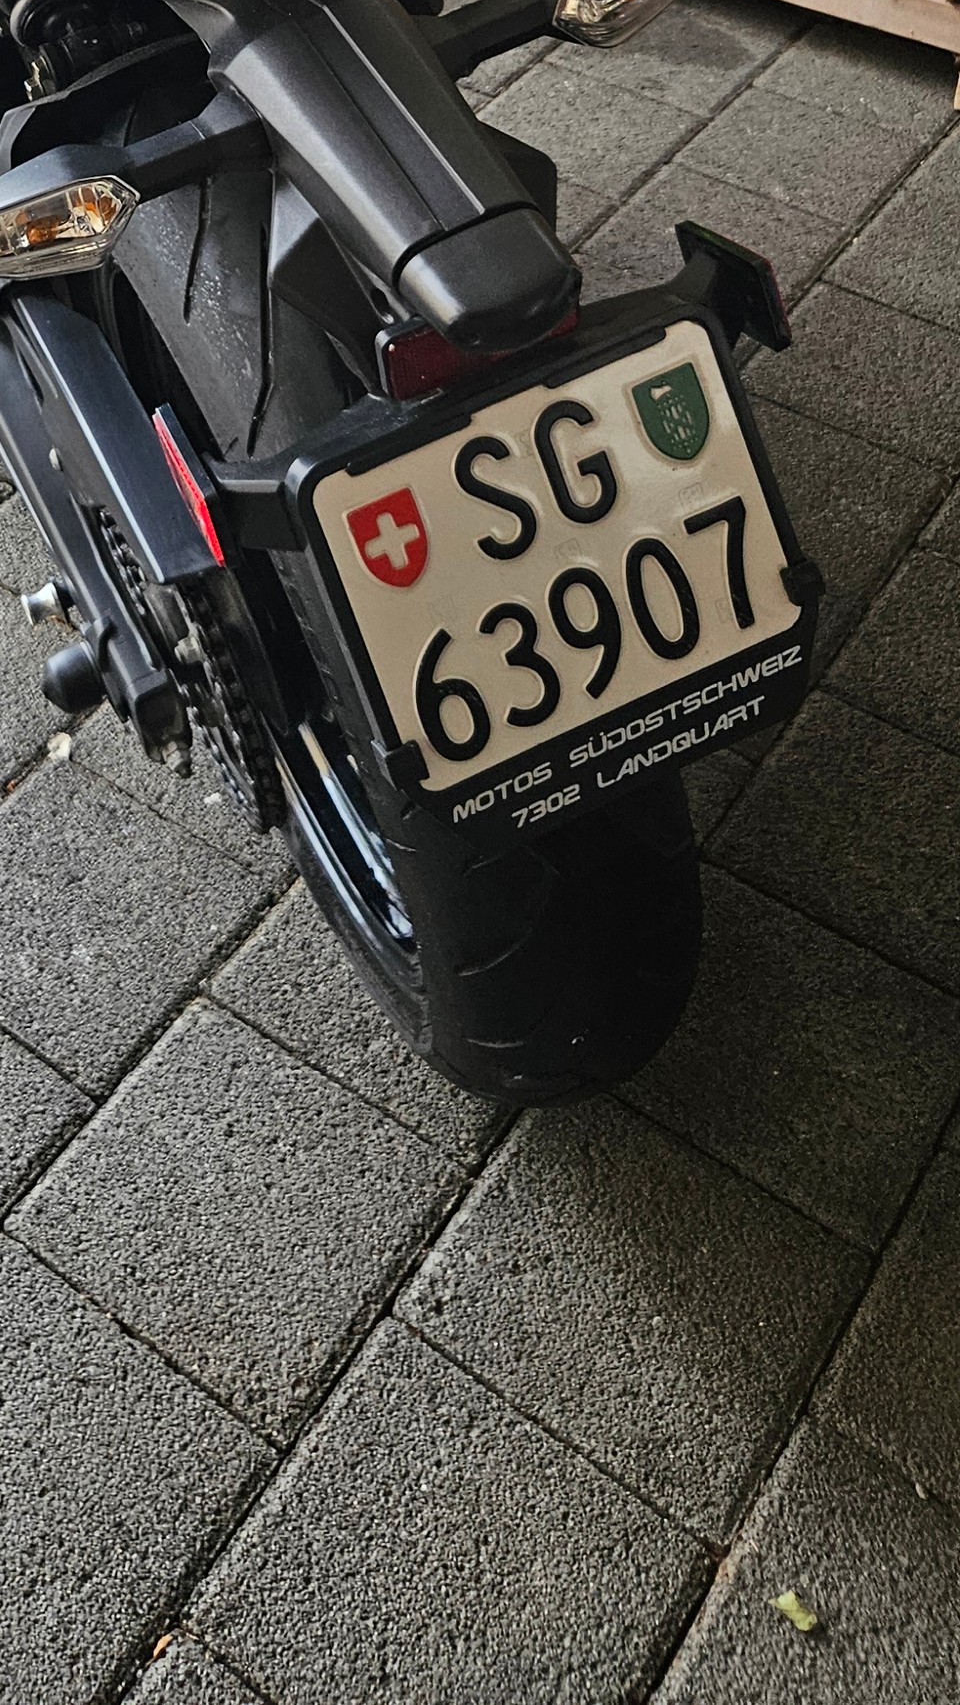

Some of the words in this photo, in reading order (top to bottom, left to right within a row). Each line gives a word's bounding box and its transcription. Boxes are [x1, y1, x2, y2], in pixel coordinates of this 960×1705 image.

[454, 399, 618, 560] SG
[414, 496, 753, 762] 63907
[452, 761, 553, 823] MOTOS
[569, 645, 803, 769] SÜDOSTSCHWEIZ
[511, 783, 581, 829] 7302
[596, 695, 766, 789] LANDQUART
